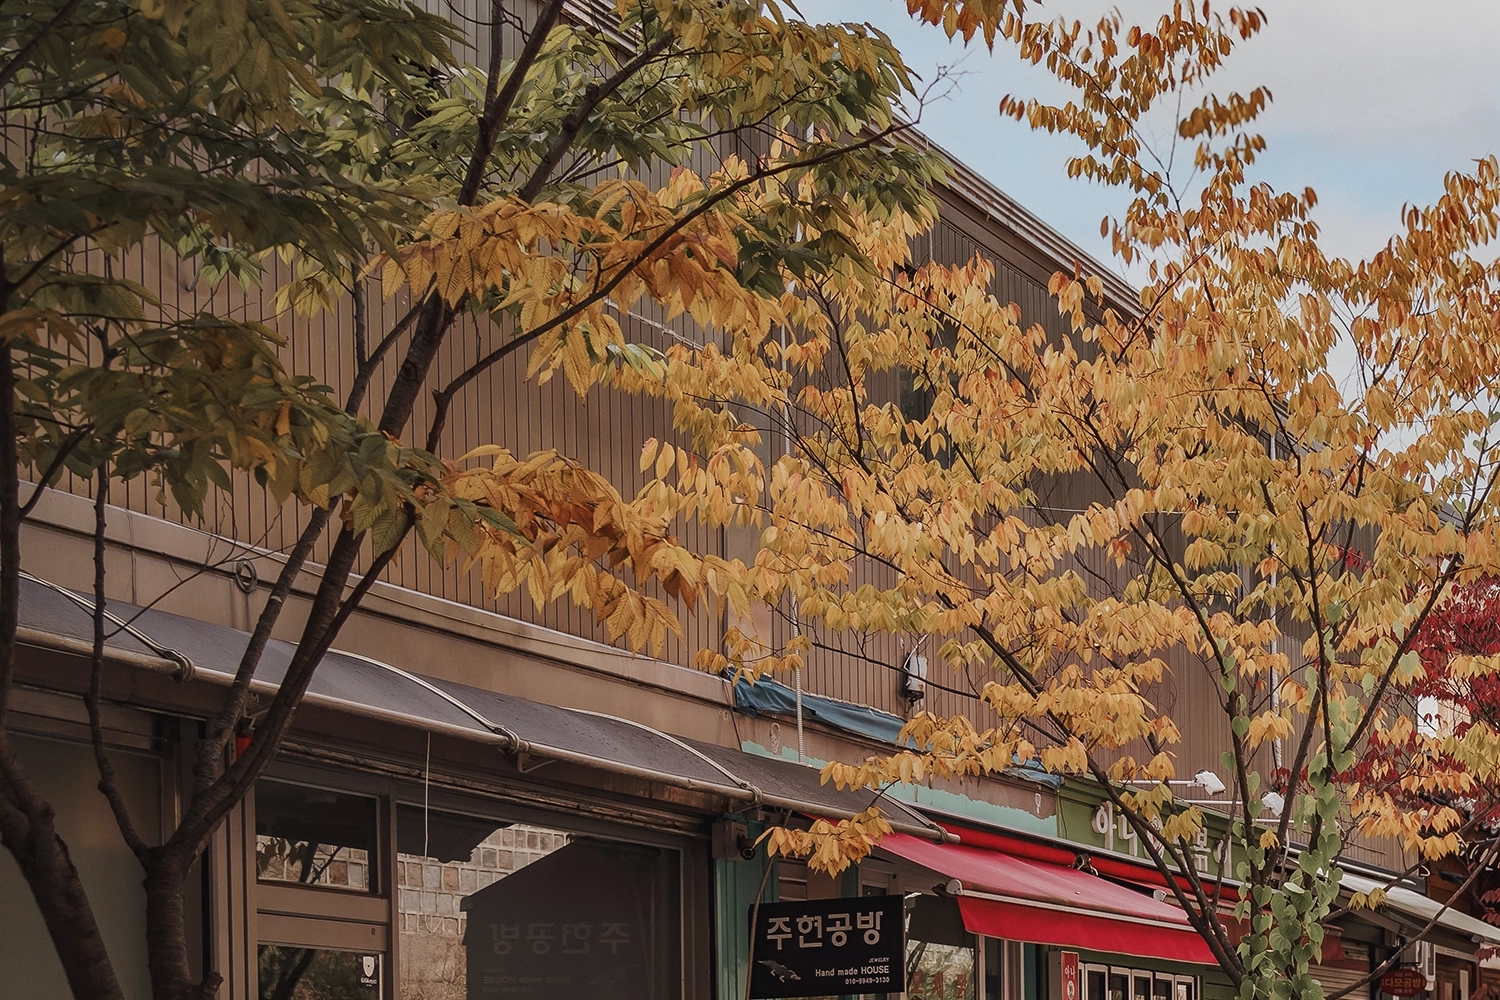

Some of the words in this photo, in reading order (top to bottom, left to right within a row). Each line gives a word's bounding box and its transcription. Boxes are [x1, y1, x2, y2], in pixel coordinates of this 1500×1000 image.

[766, 910, 884, 951] 주현공방
[815, 967, 835, 977] Hand
[838, 966, 859, 976] made
[861, 965, 890, 975] HOUSE
[844, 976, 890, 985] 010-9949-3130
